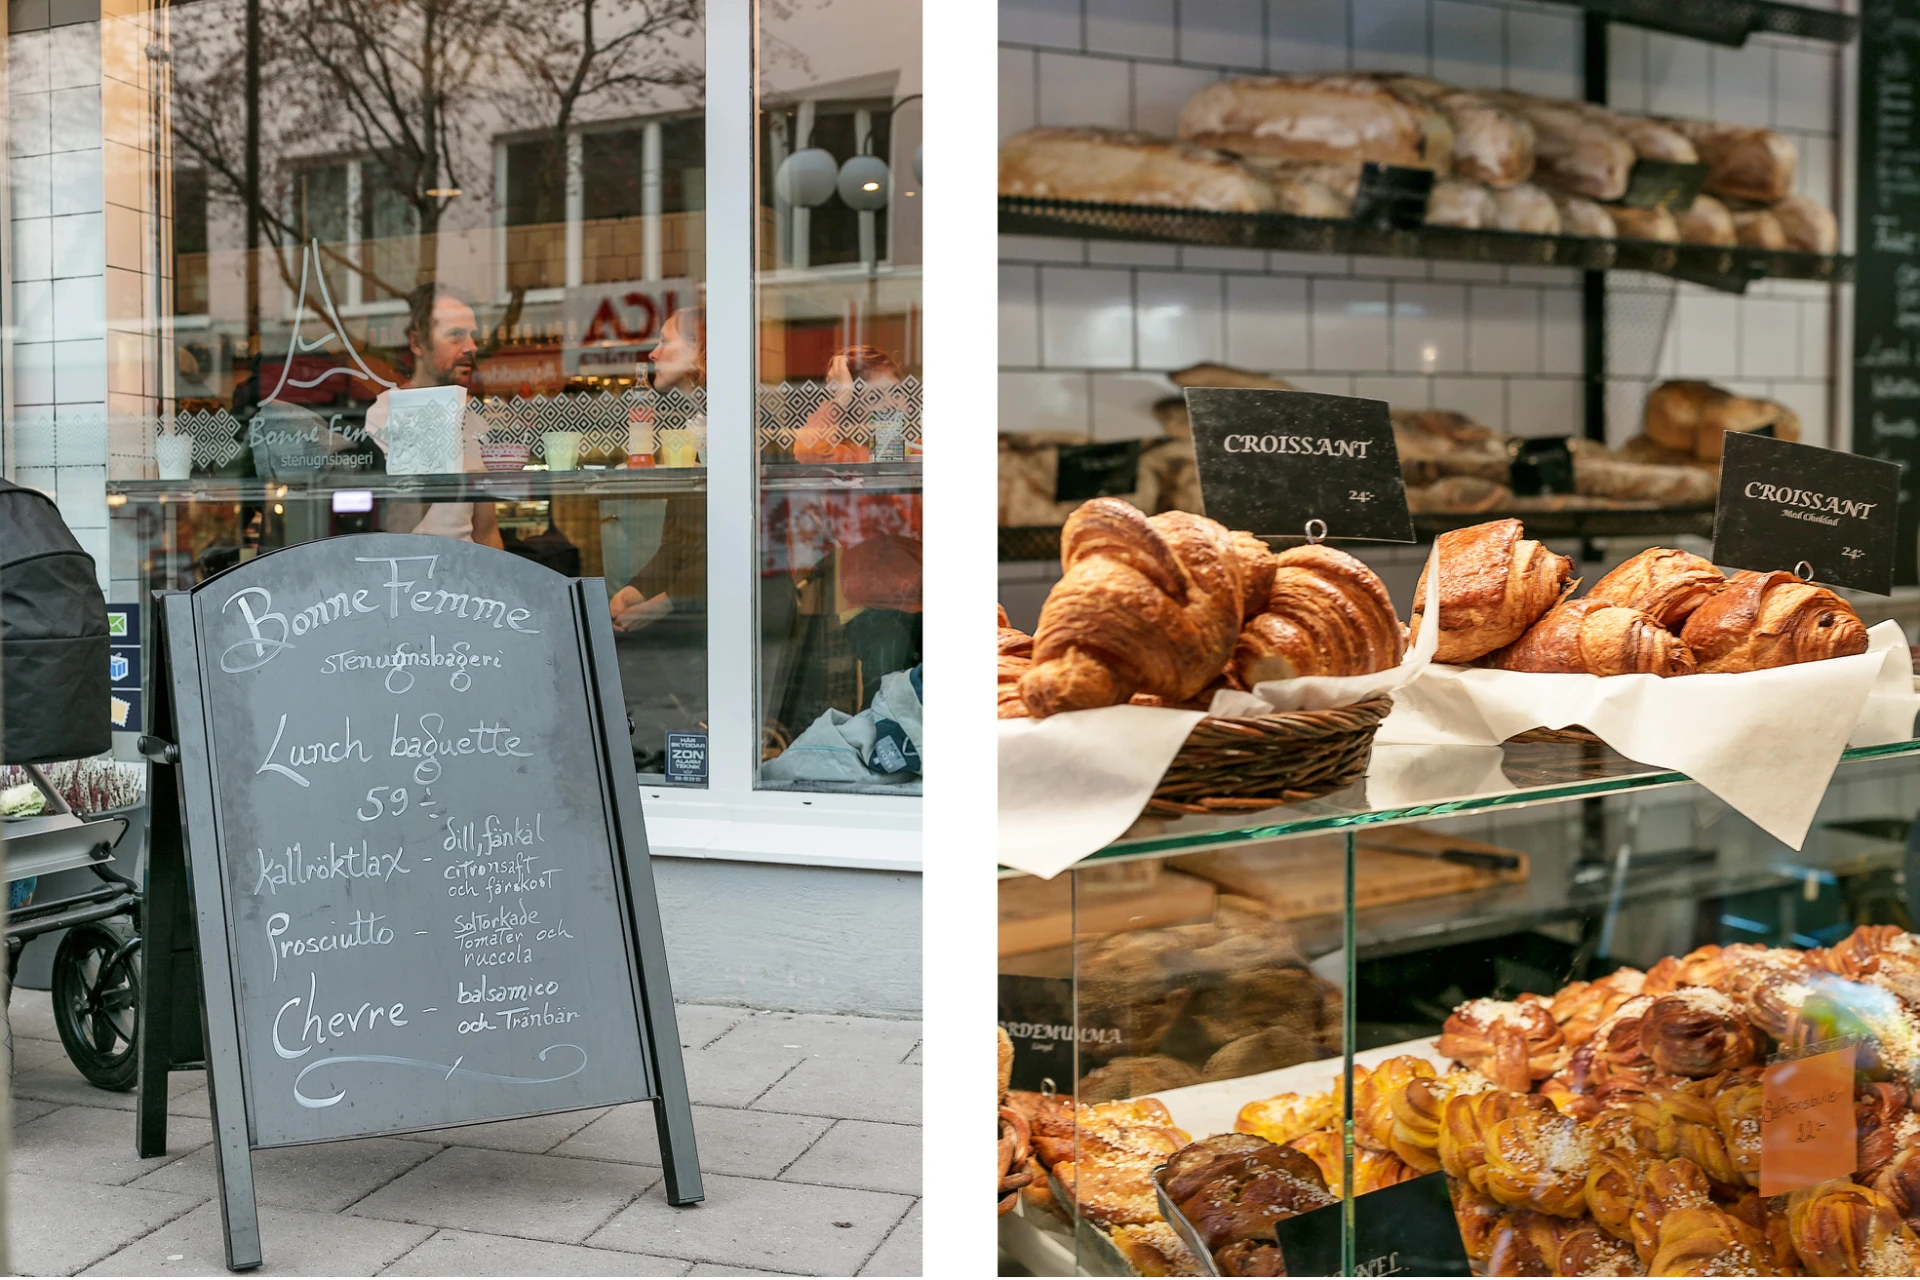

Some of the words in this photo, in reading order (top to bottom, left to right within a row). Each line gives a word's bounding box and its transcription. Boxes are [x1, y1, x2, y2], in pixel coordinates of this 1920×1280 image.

[249, 415, 320, 449] Bonne
[281, 451, 373, 469] stenugnsbageri
[1223, 434, 1373, 459] CROISSANT
[1744, 481, 1878, 520] CROISSANT
[220, 587, 381, 673] Bonne
[354, 554, 541, 635] Femme
[256, 713, 374, 787] Lunch
[390, 713, 534, 785] baguette
[672, 749, 704, 760] ZON
[448, 880, 479, 897] och
[536, 918, 574, 941] och
[265, 910, 395, 983] Prosciutto
[464, 943, 533, 968] ruccola
[457, 973, 560, 1004] balsamico
[271, 971, 409, 1059] Chevre
[457, 1012, 497, 1035] och
